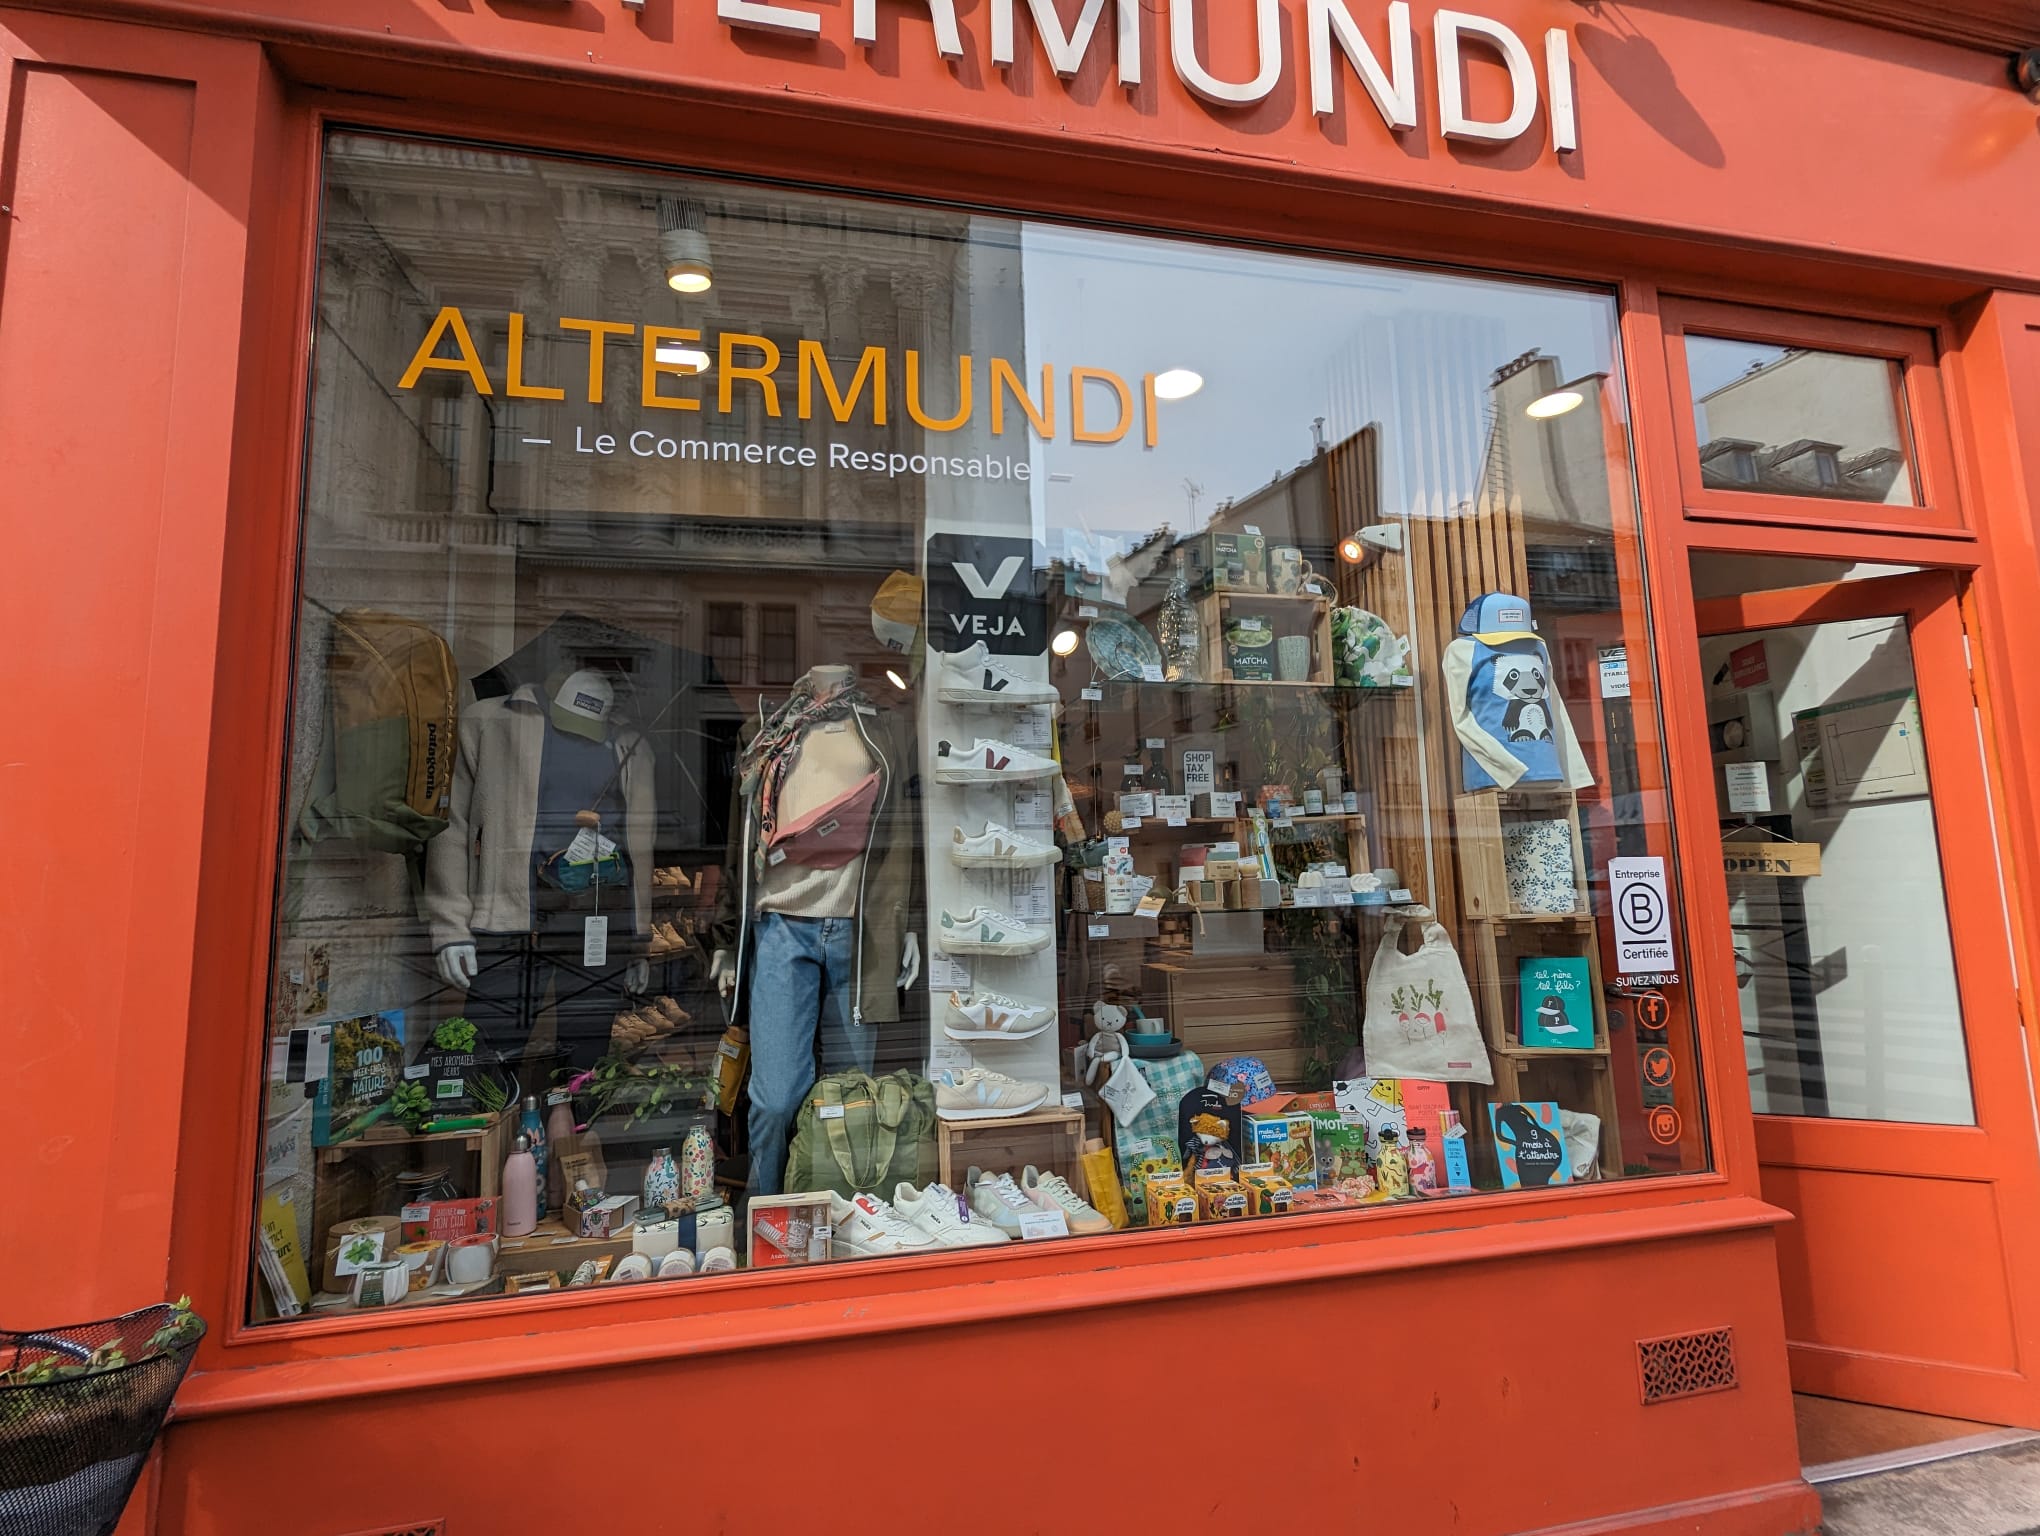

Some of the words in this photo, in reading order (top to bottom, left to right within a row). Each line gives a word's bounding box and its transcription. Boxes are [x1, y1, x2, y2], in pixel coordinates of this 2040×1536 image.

[397, 306, 1158, 448] ALTERMUNDI
[575, 426, 616, 455] Le
[629, 430, 818, 466] Commerce
[829, 443, 1031, 481] Responsable
[950, 614, 1026, 636] VEJA
[1233, 656, 1268, 665] MATCHA
[426, 722, 437, 800] patagonia
[1185, 753, 1211, 763] SHOP
[1186, 764, 1204, 773] TAX
[1186, 773, 1210, 783] FREE
[1723, 859, 1792, 873] OPEN
[1615, 869, 1661, 880] Entreprise
[1631, 893, 1652, 924] B
[1623, 948, 1669, 960] Certifiée
[1551, 968, 1573, 982] père
[1616, 974, 1680, 987] SUIVEZ-NOUS
[356, 1046, 383, 1067] 100
[444, 1054, 475, 1066] AROMATES
[353, 1062, 386, 1078] WEEK-ENDS
[352, 1074, 386, 1096] NATURE
[362, 1090, 383, 1101] FRANCE
